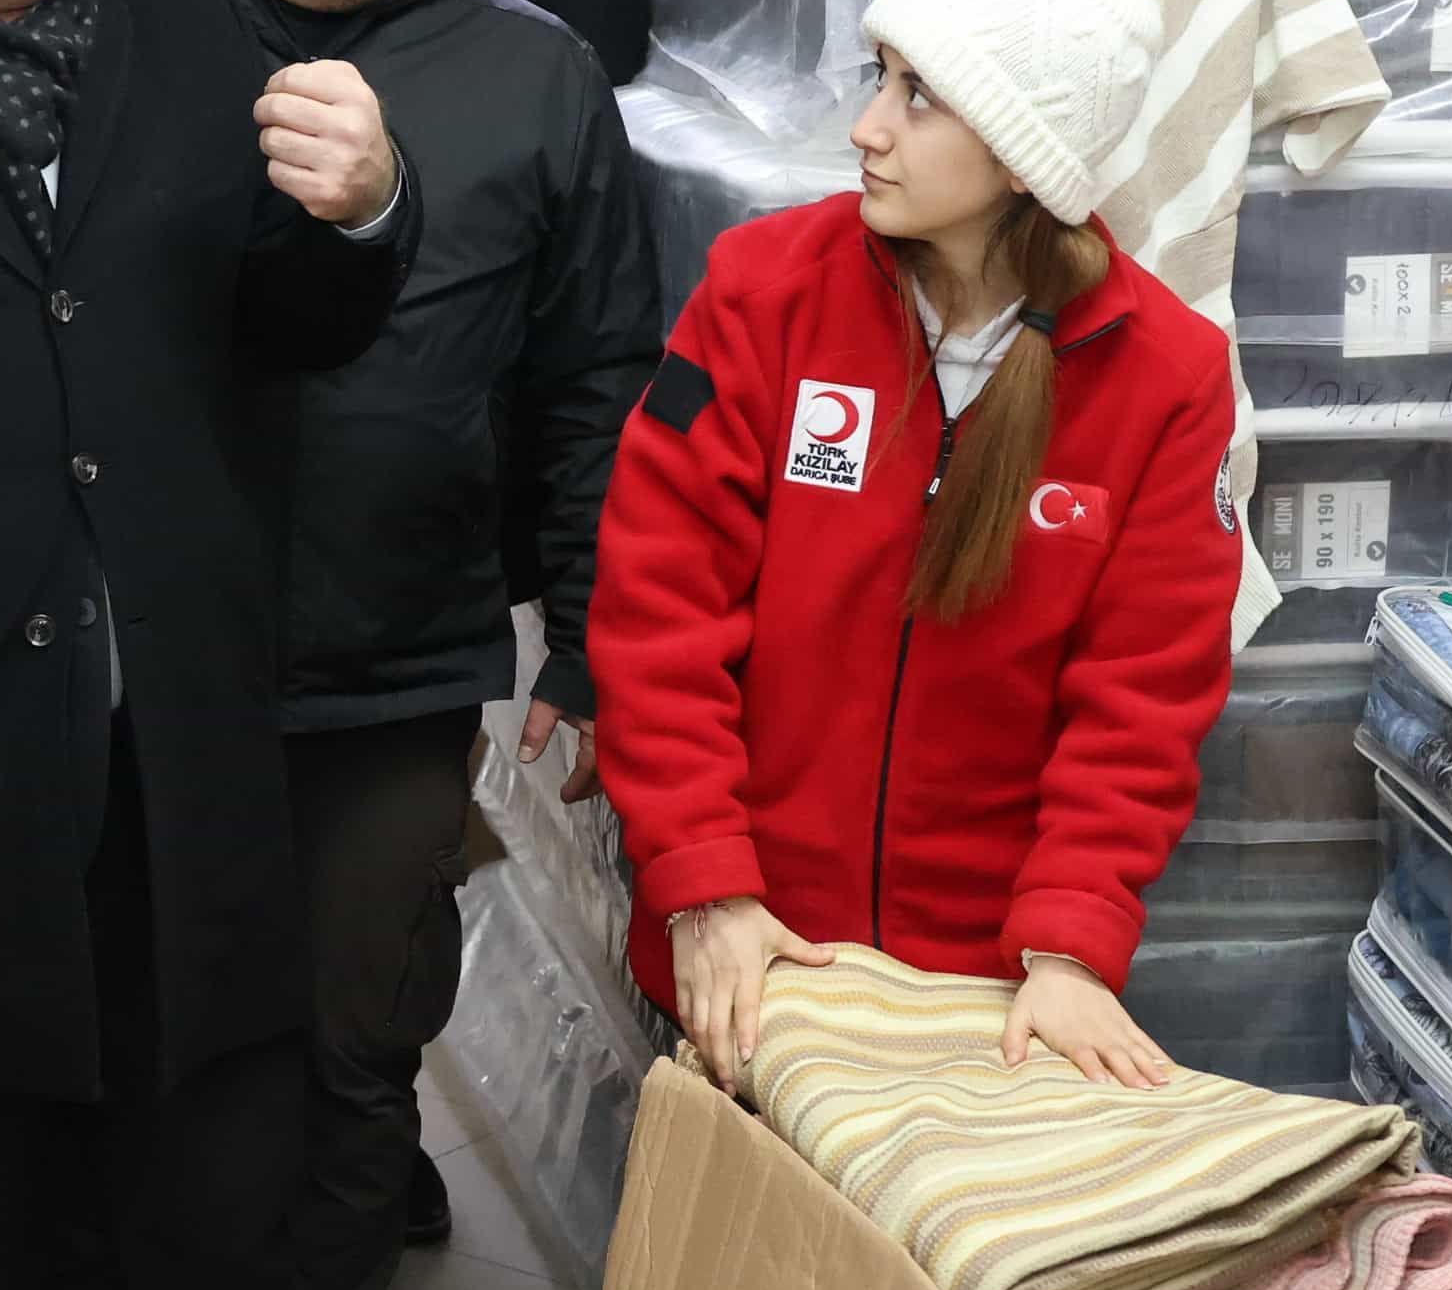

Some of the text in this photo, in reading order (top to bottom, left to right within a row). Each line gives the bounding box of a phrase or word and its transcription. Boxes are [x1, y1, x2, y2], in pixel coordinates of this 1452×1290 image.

[807, 442, 849, 460] TÜRK
[793, 452, 859, 475] KIZILAY
[830, 472, 858, 486] ŞUBE
[1317, 493, 1335, 526] 190
[1316, 546, 1334, 569] 90
